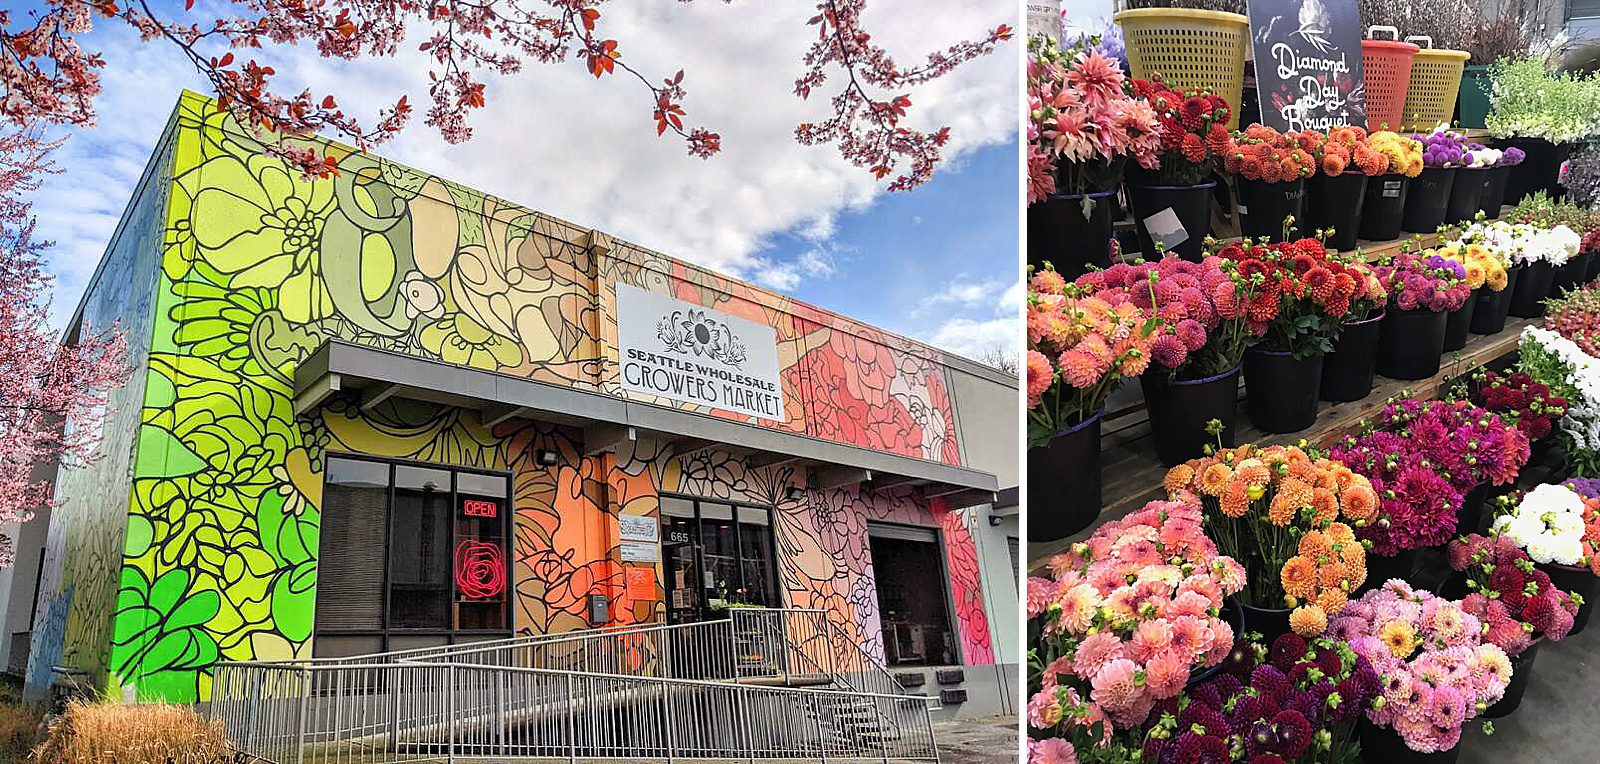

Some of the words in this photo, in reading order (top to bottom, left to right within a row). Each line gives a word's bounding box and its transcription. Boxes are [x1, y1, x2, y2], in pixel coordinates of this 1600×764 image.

[1271, 43, 1349, 79] Diamond
[1300, 75, 1346, 111] Day
[1281, 104, 1351, 135] Bouquet
[627, 348, 694, 372] SEATTLE
[696, 362, 775, 392] WHOLESALE
[624, 362, 717, 402] GROWERS
[722, 383, 780, 417] MARKET
[466, 502, 495, 515] OPEN
